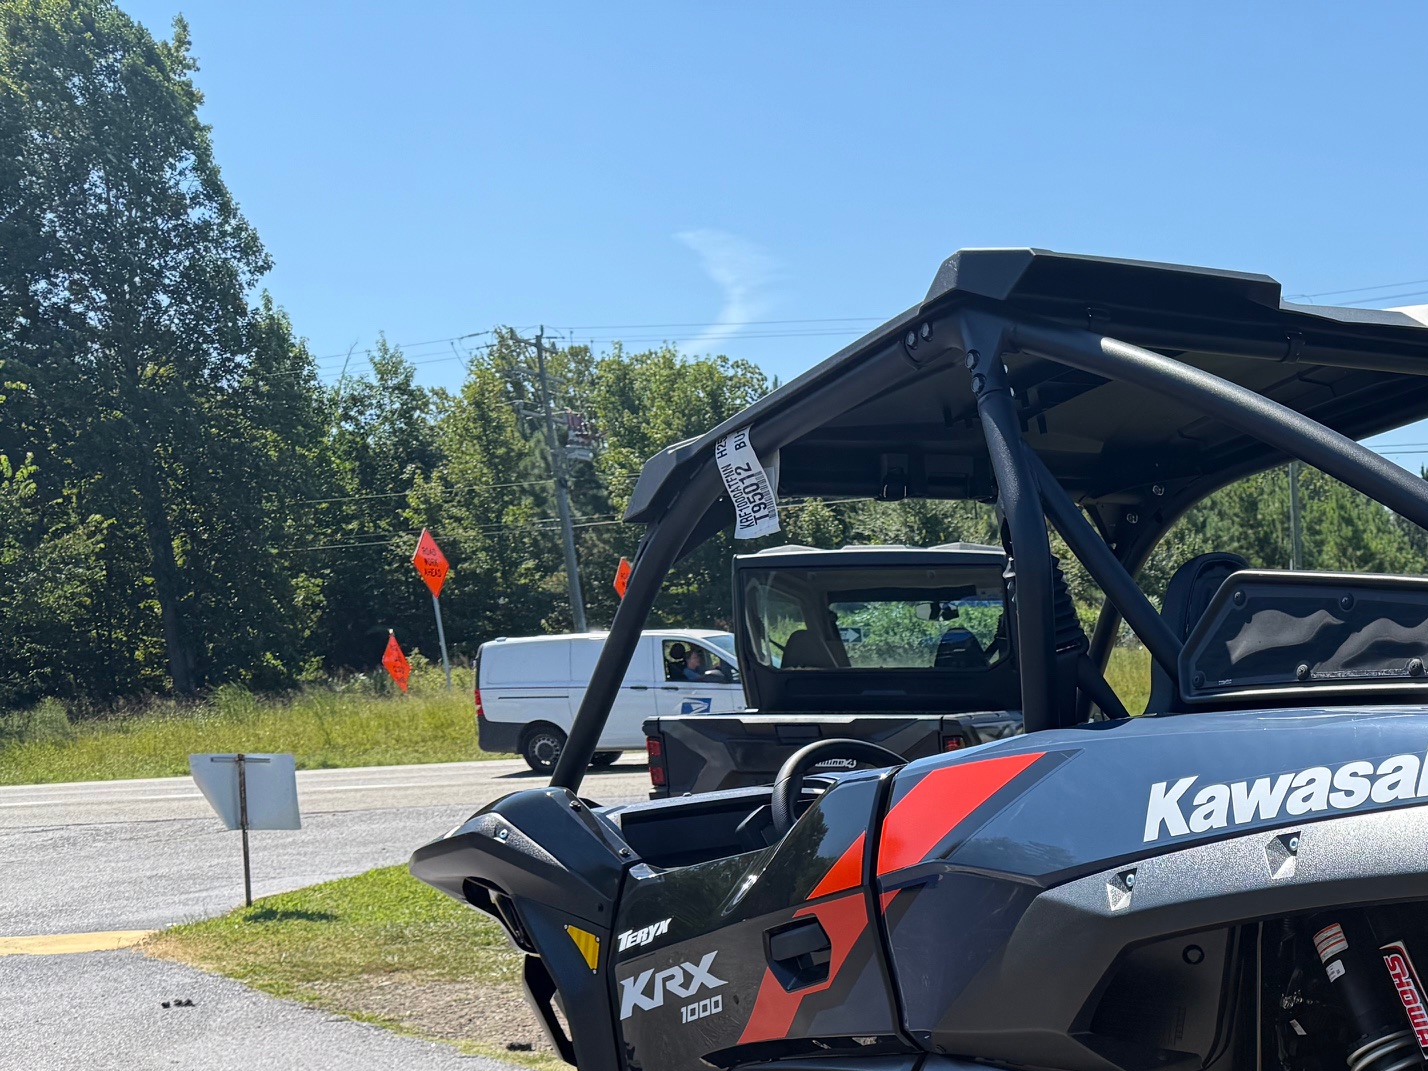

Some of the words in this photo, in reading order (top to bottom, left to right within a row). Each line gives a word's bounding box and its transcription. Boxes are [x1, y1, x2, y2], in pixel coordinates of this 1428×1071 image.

[734, 462, 770, 526] T95012
[619, 950, 729, 1021] KRX
[680, 994, 723, 1024] 1000
